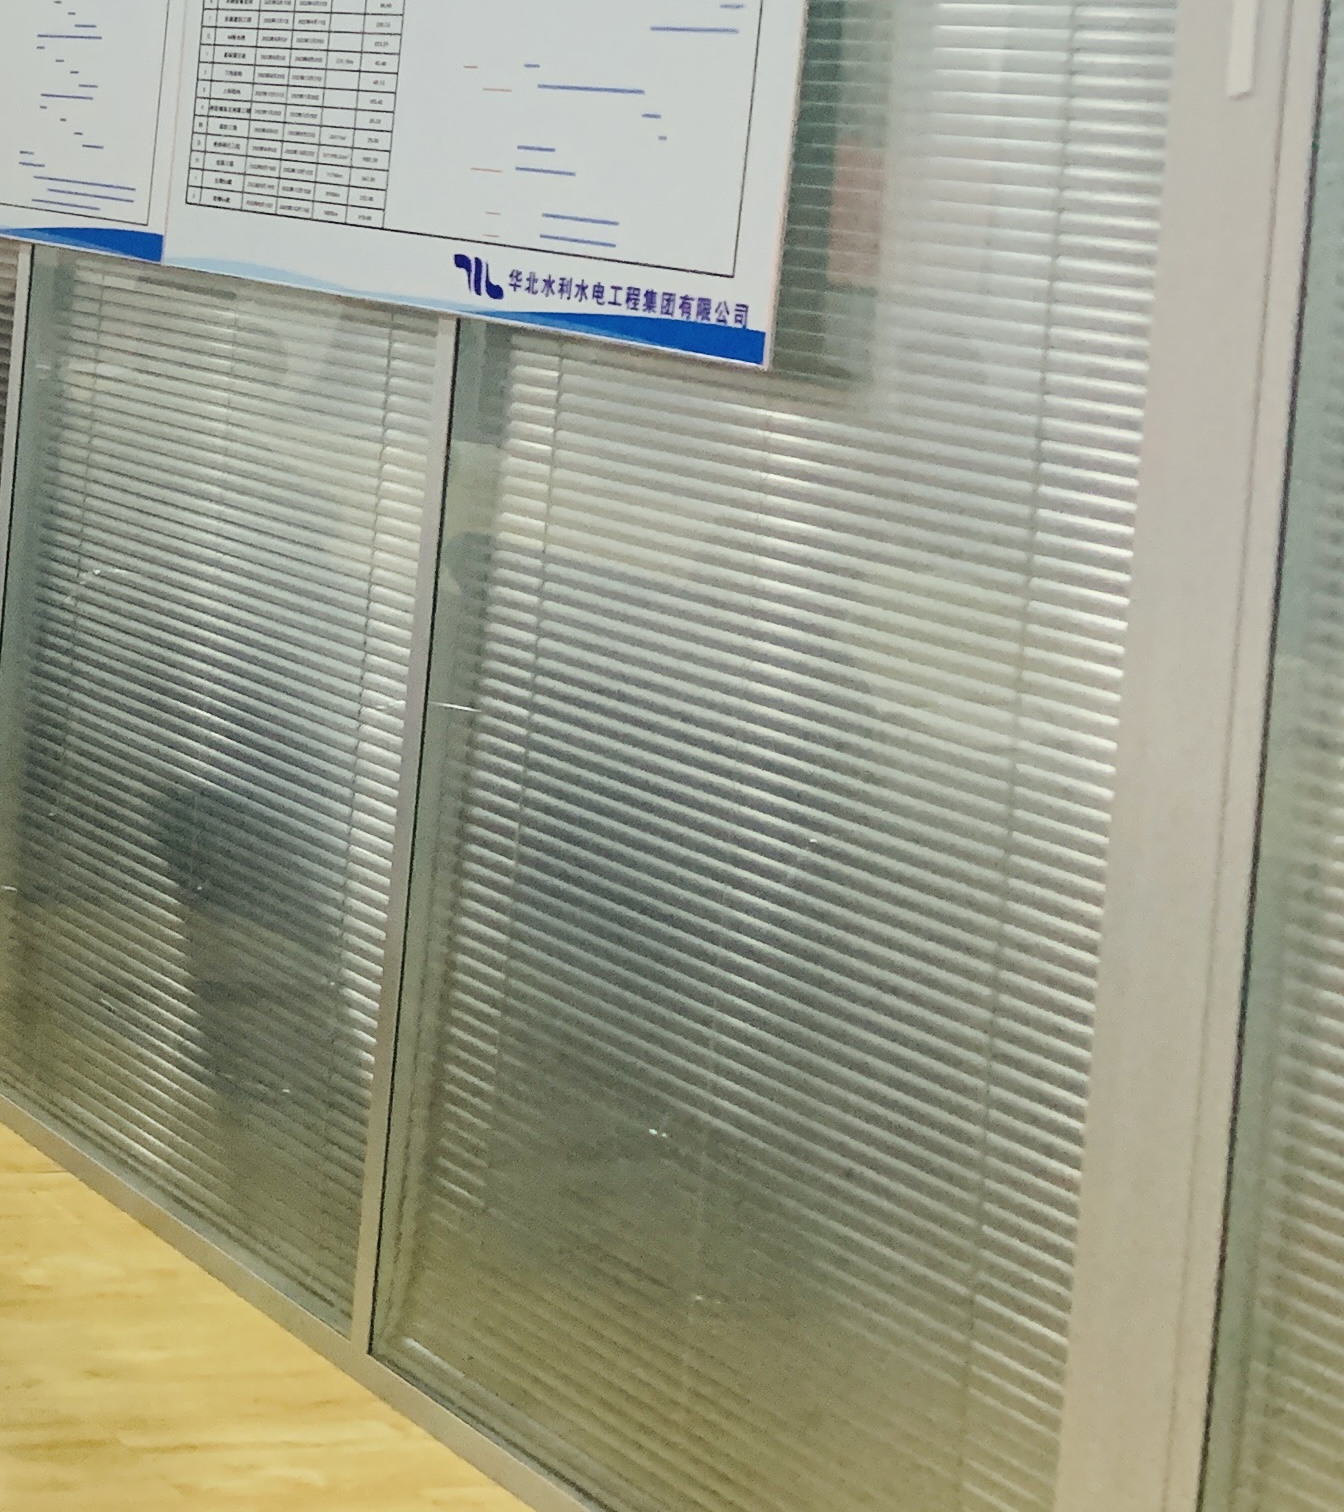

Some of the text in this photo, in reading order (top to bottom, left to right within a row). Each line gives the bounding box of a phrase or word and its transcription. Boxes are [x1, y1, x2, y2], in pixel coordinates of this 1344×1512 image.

[508, 268, 750, 330] 华北水利水电工程集团有限公司
